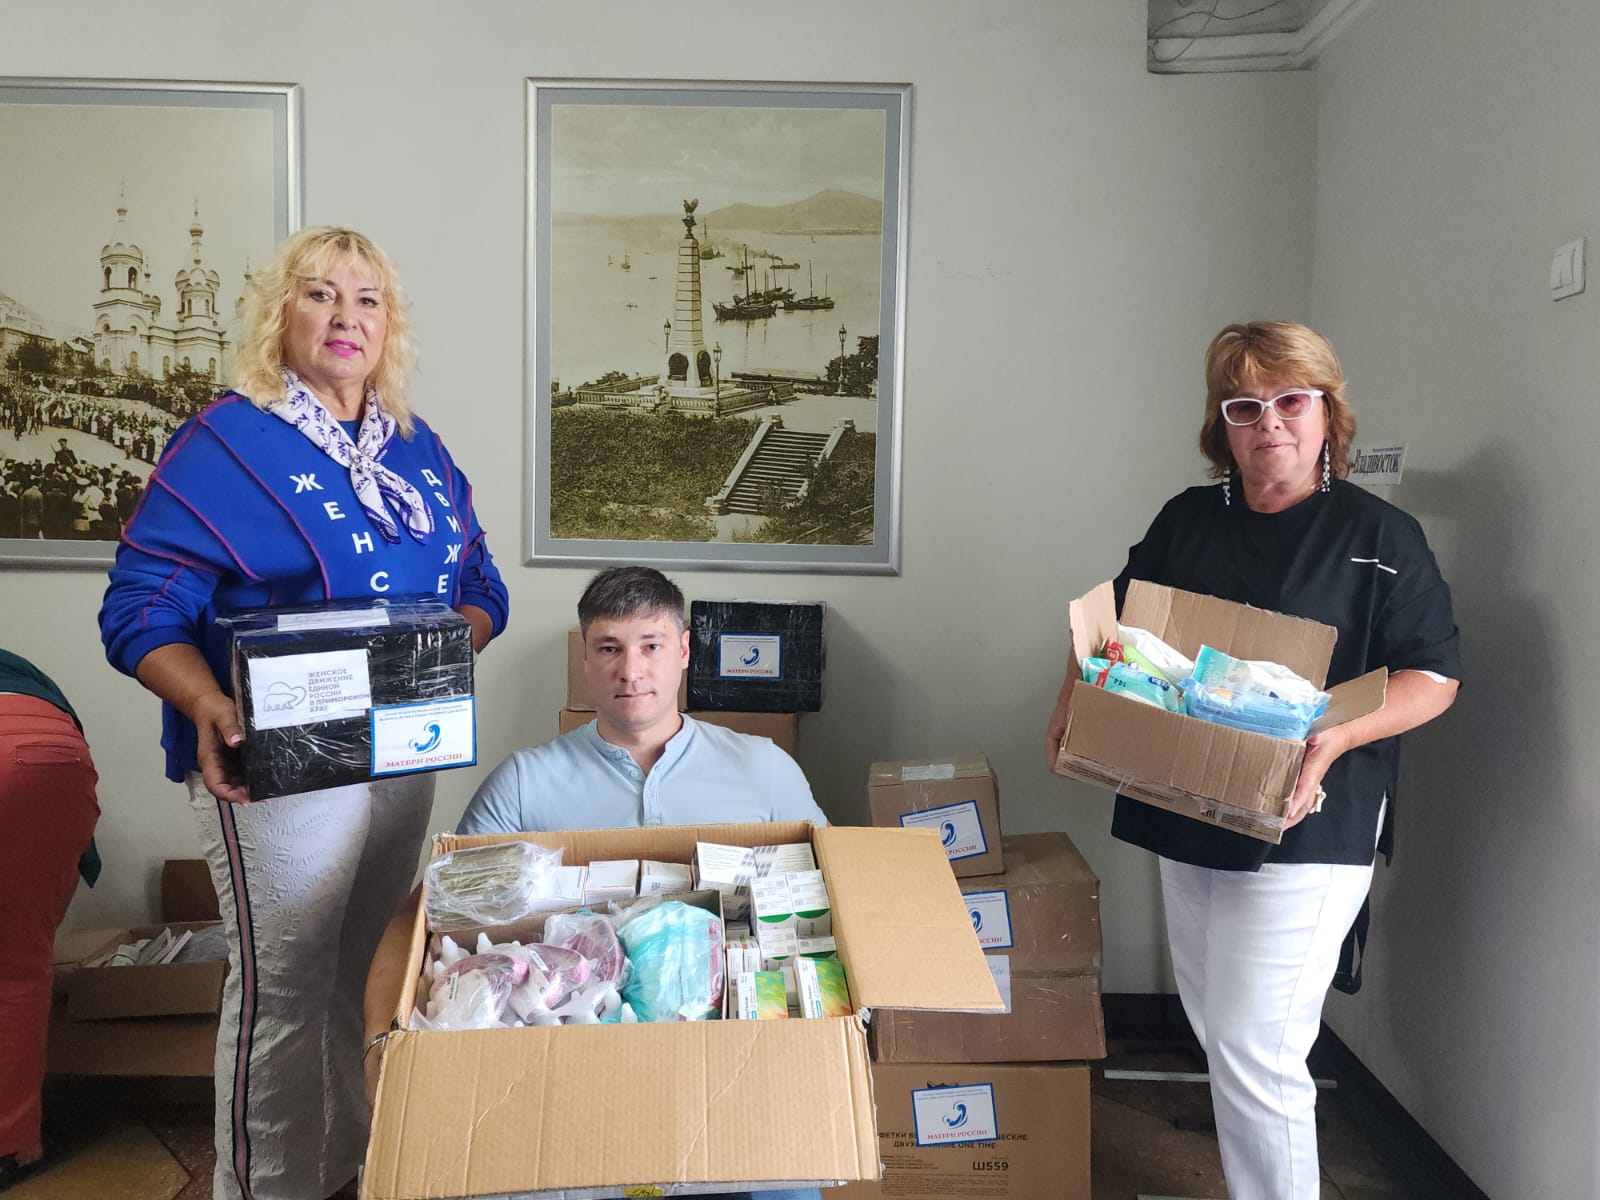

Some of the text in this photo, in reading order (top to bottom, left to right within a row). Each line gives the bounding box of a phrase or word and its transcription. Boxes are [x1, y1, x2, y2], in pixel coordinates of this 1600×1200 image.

[308, 668, 347, 678] ЖЕНСКОЕ
[308, 674, 353, 685] ДВИЖЕНИЕ
[308, 683, 340, 692] ЕДИНОЙ
[309, 690, 342, 699] РОССИИ
[386, 752, 463, 768] МАТЕРИ РОССИИ
[948, 845, 977, 855] РОССИИ
[927, 1129, 988, 1140] МАТЕРИ РОССИИ
[998, 1133, 1028, 1142] ЕСКИЕ
[972, 1161, 1009, 1171] Ш559
